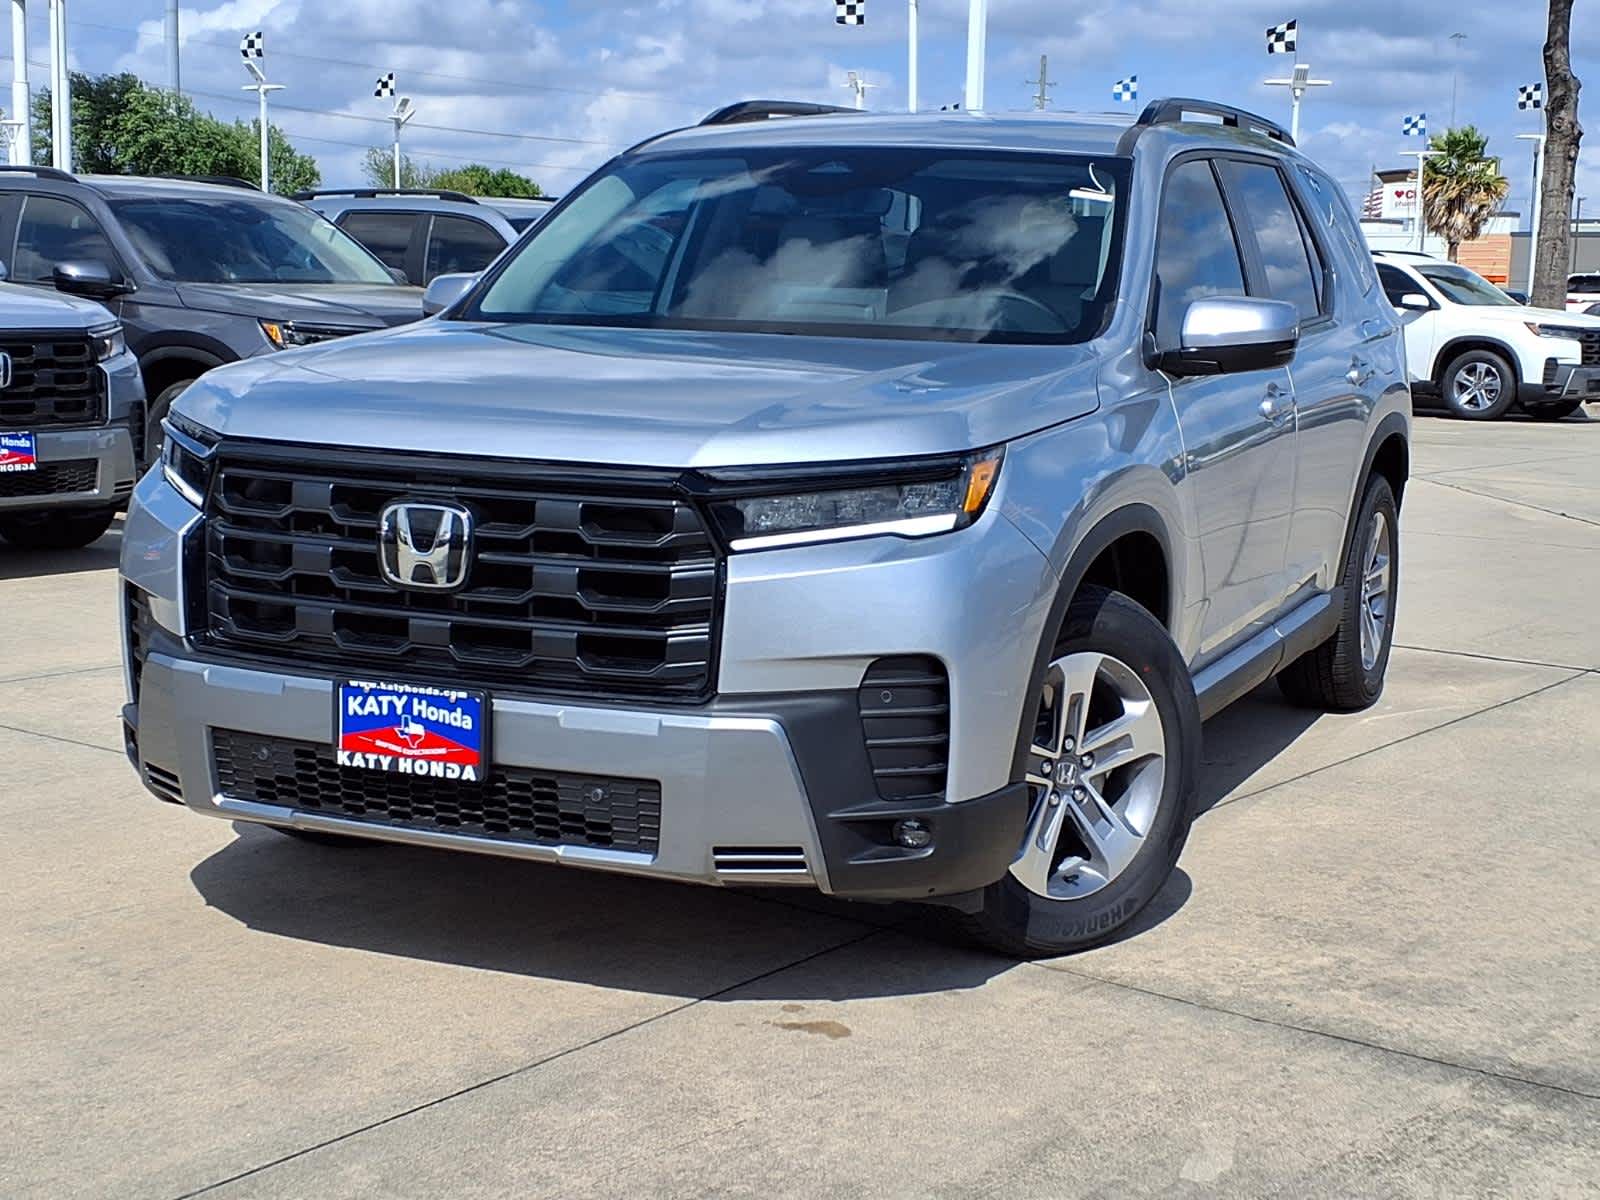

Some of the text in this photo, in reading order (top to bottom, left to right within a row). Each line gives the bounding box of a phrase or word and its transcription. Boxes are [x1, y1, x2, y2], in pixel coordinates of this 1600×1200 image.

[1, 436, 31, 448] Honda
[347, 695, 473, 730] KATY Honda
[336, 750, 477, 782] KATY HONDA
